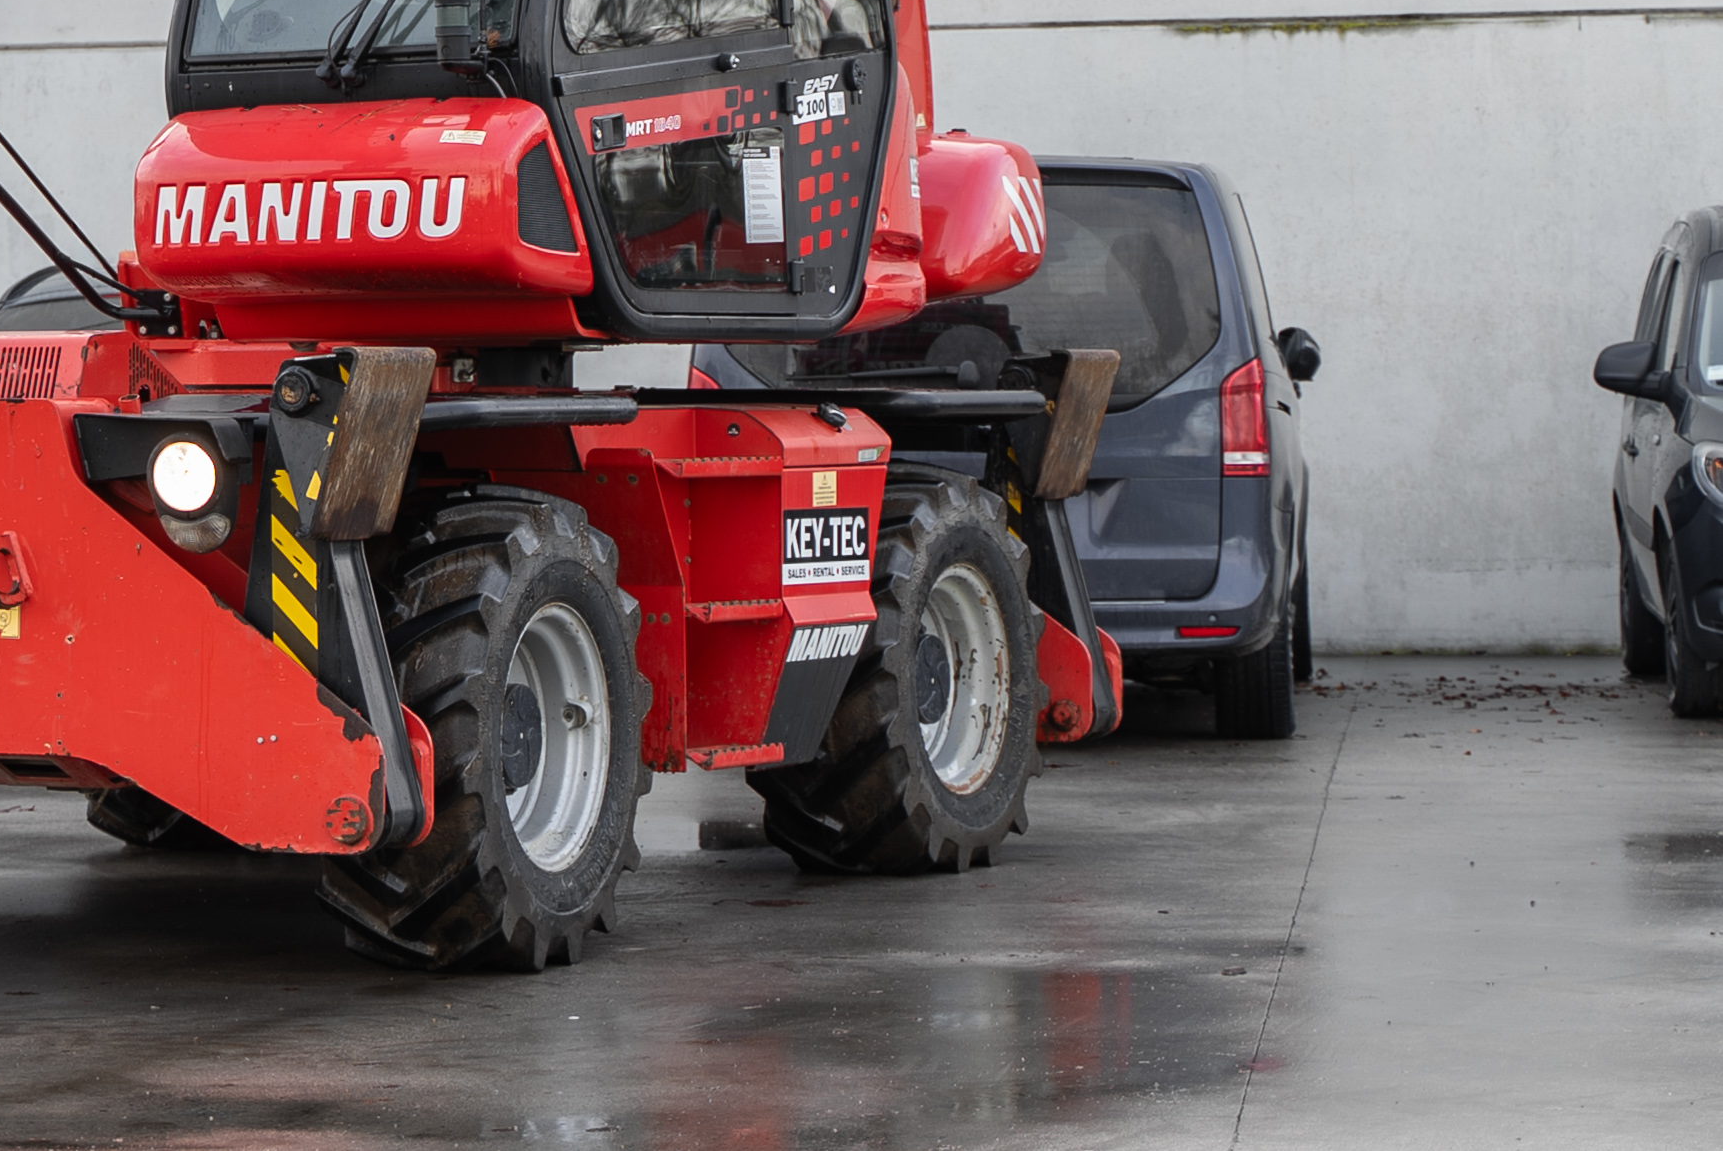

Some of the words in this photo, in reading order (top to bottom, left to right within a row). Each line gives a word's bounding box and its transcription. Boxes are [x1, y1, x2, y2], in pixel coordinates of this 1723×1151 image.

[803, 73, 839, 95] EASY
[806, 98, 825, 115] 100
[626, 118, 653, 137] MRT
[153, 176, 466, 244] MANITOU
[786, 515, 866, 559] KEY-TEC
[787, 568, 807, 580] SALES
[812, 566, 835, 578] RENTAL
[841, 564, 865, 576] SERVICE
[786, 623, 870, 663] MANITOU
